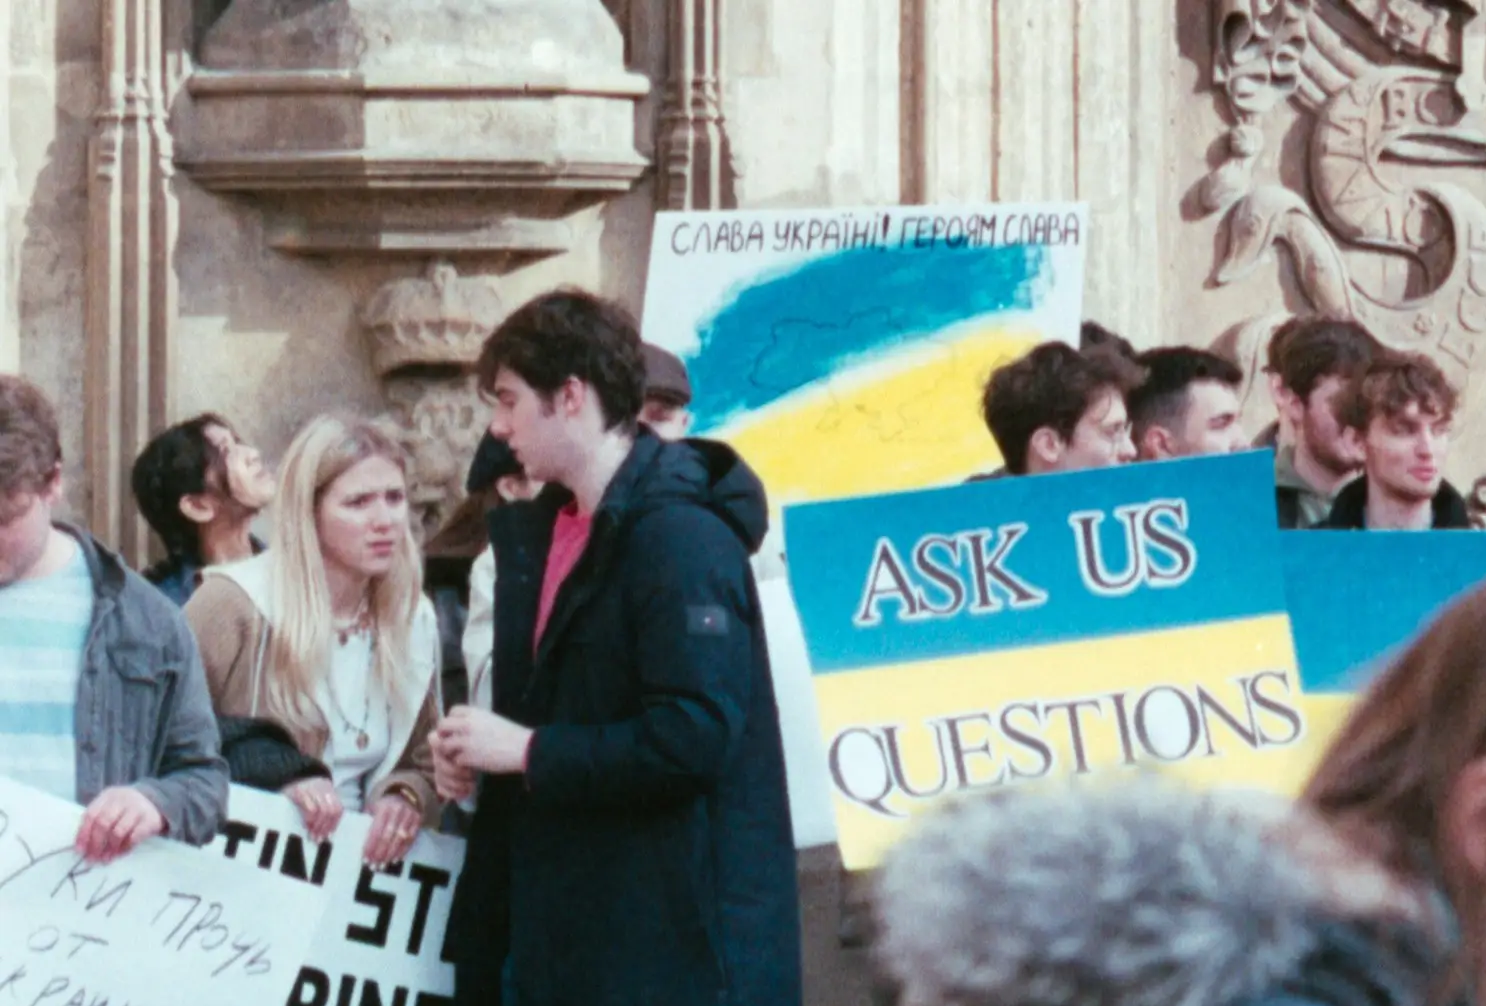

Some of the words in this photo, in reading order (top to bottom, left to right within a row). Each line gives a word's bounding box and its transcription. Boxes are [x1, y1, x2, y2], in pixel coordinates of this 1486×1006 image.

[671, 221, 765, 255] СЛАВА
[772, 213, 891, 252] УКРАЇНІ!
[900, 212, 997, 252] ГЕРОЯМ
[1003, 211, 1080, 247] СЛАВА
[854, 521, 1047, 627] ASK
[1068, 498, 1198, 596] US
[828, 668, 1305, 818] QUESTIONS
[27, 925, 109, 960] ОТ
[149, 889, 272, 978] ПРОЧЬ
[346, 860, 455, 962] ST
